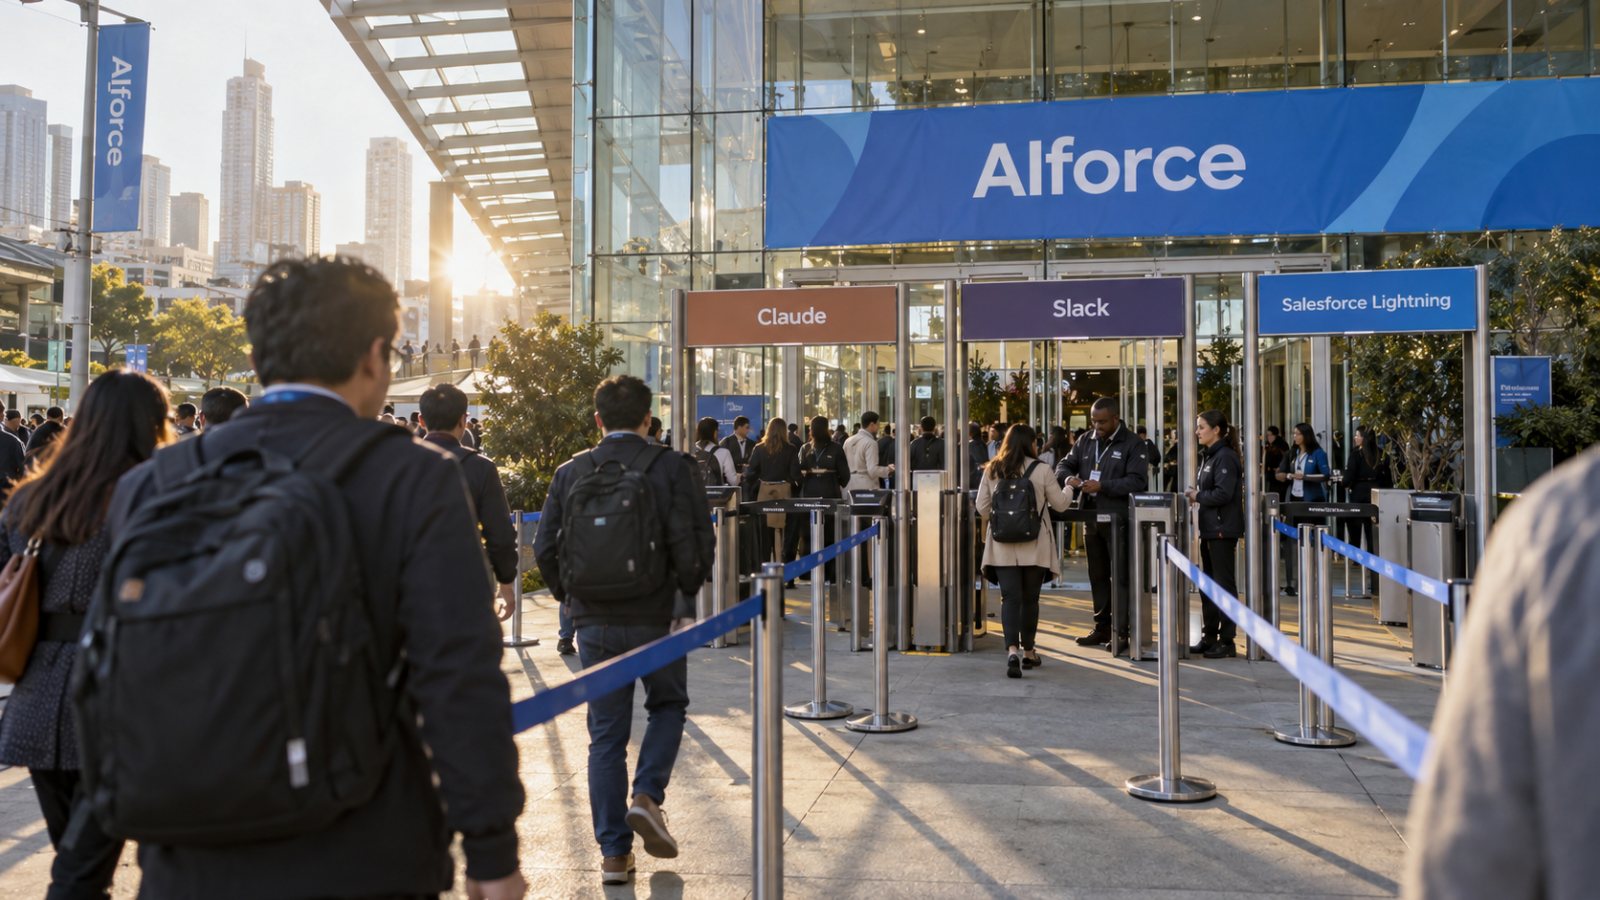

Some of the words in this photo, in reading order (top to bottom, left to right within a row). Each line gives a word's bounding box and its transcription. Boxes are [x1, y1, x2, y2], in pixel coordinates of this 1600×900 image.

[972, 136, 1247, 198] AIforce
[1053, 297, 1110, 318] Slack
[1282, 296, 1367, 312] Salesforce
[1372, 293, 1451, 312] Lightning
[757, 306, 827, 326] Claude
